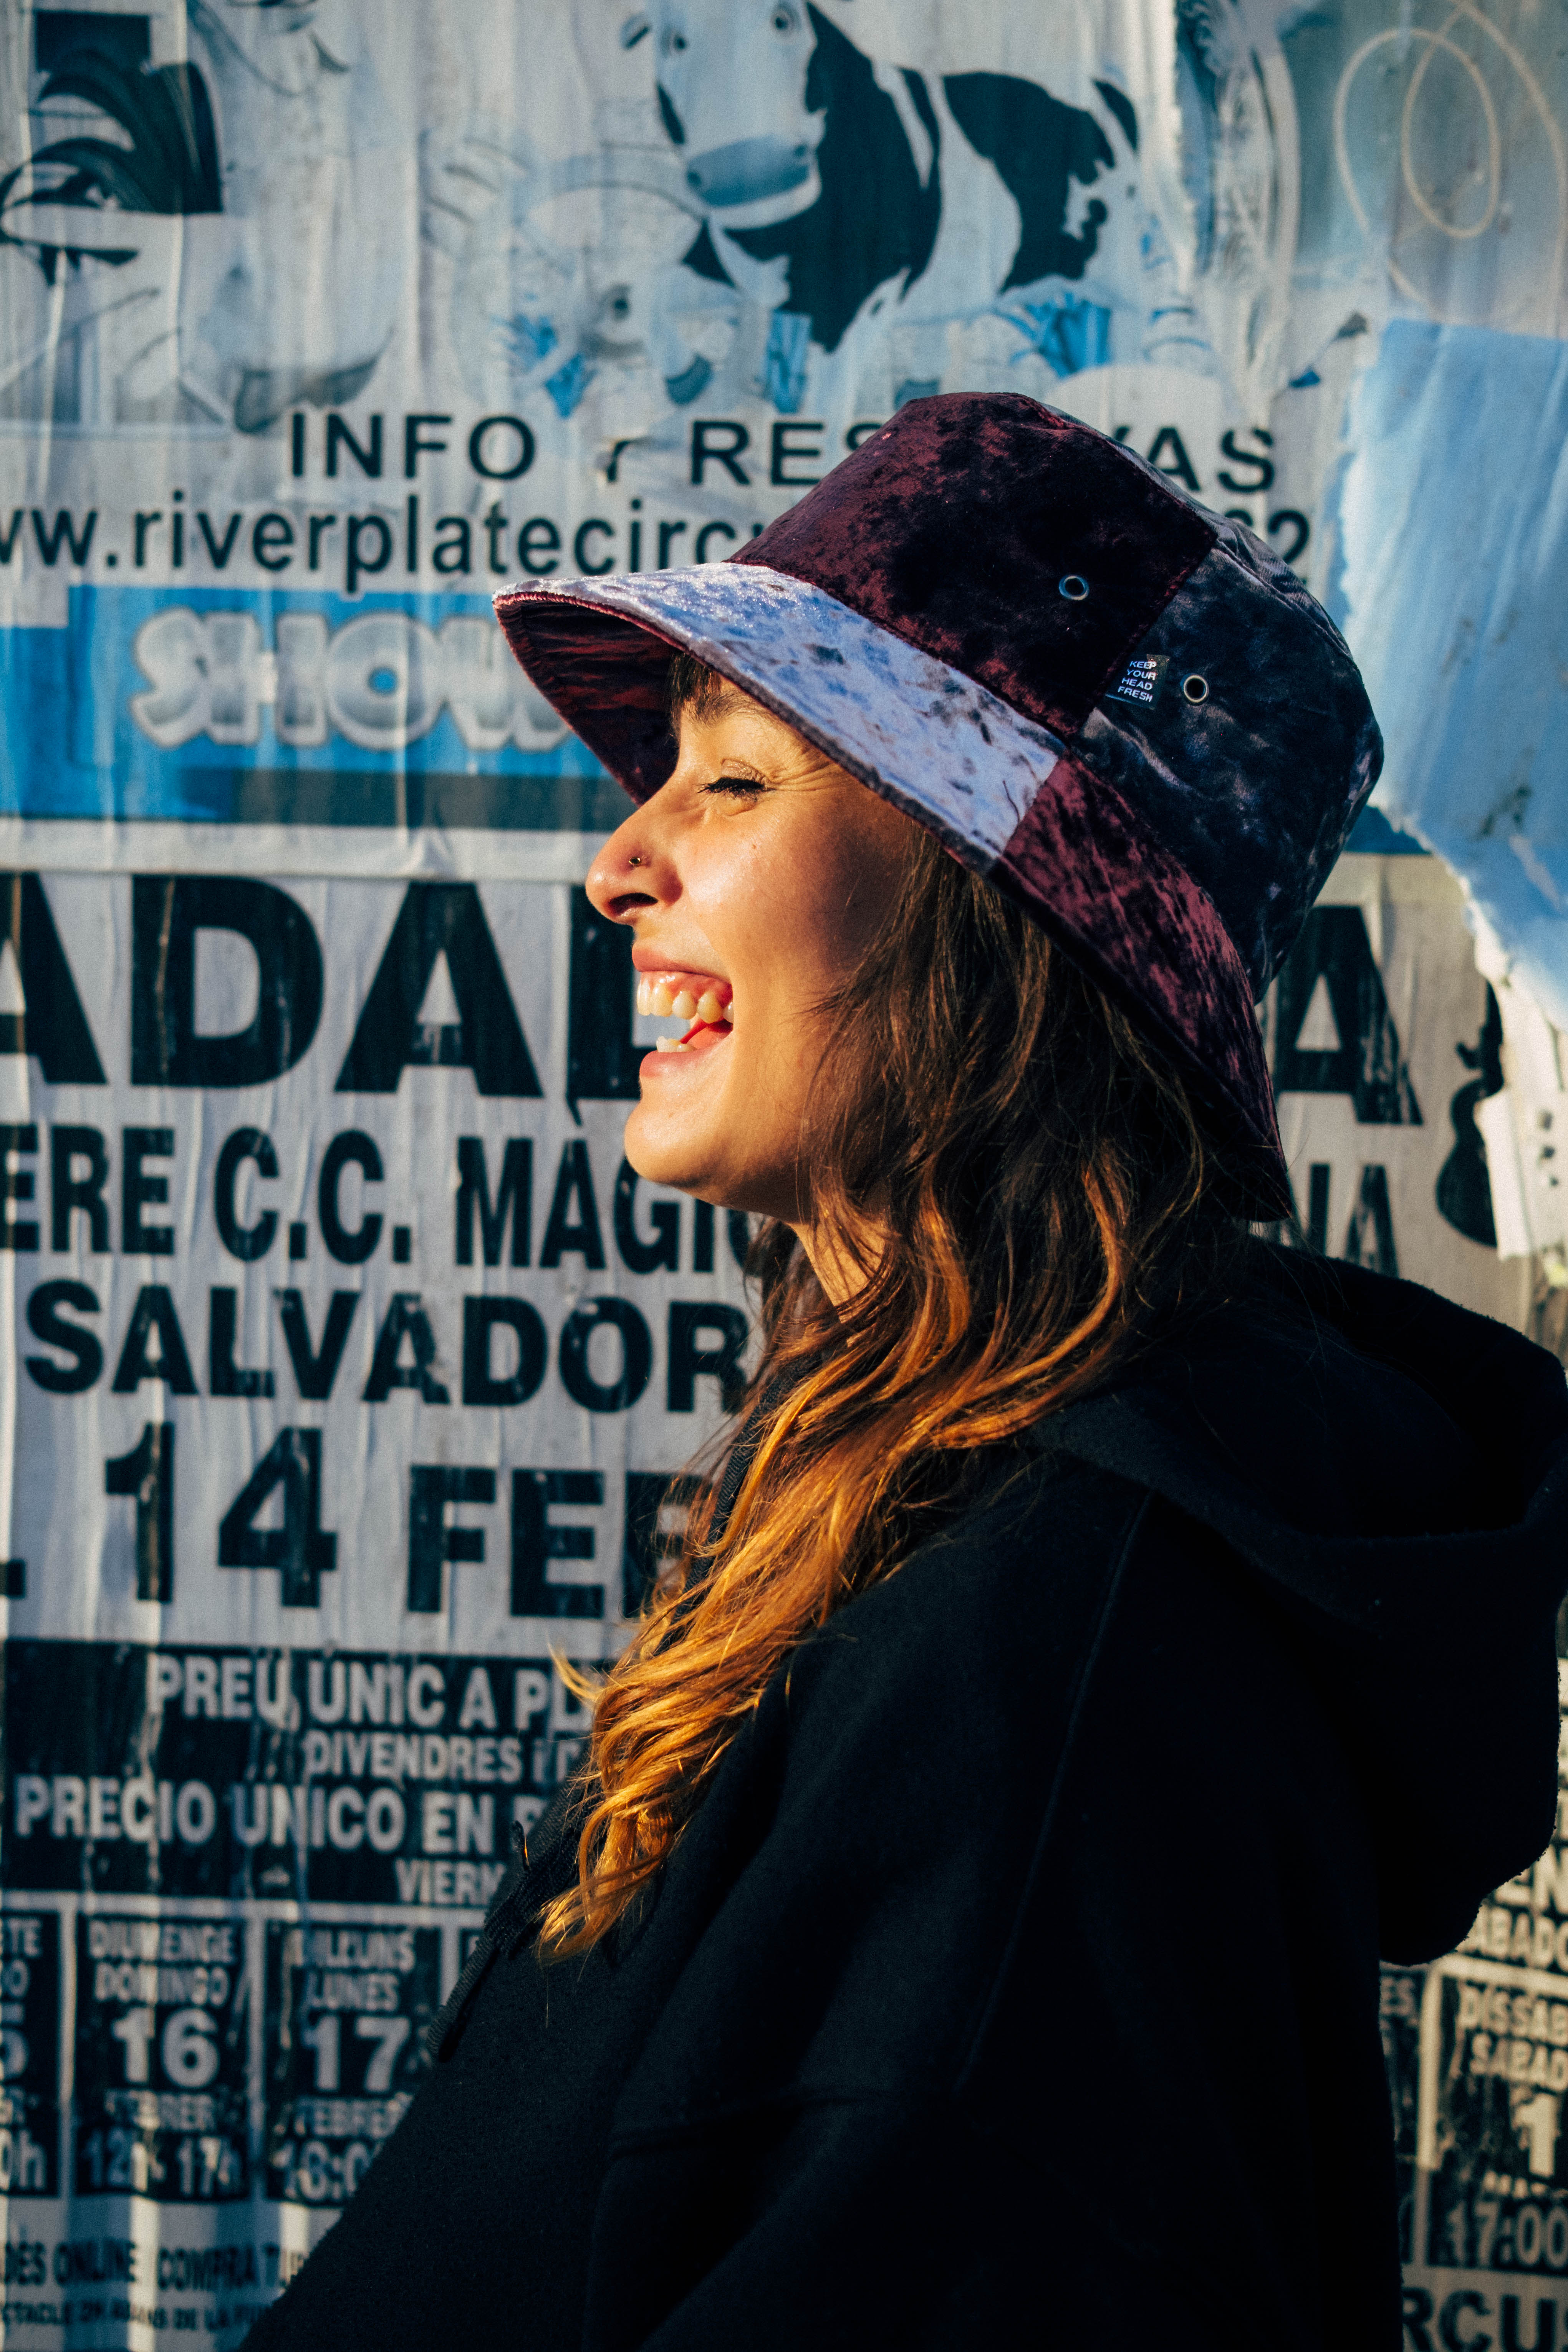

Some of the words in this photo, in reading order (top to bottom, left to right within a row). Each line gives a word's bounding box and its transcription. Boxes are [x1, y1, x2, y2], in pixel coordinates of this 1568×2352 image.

[291, 412, 535, 480] INFO
[0, 491, 765, 593] w.riverplatecirc
[1118, 686, 1152, 702] FRESH
[1122, 677, 1152, 691] HEAD
[1126, 669, 1156, 681] YOUR
[1129, 661, 1157, 669] KEEP
[214, 1125, 413, 1266] C.C.
[24, 1277, 753, 1414] SALVADOR
[104, 1421, 339, 1610] 14
[145, 1653, 292, 1723] PREU
[460, 1666, 498, 1730] A
[514, 1668, 593, 1731] PL
[306, 1729, 523, 1785] DIVENDRES
[14, 1774, 216, 1844] PRECIO
[421, 1791, 494, 1855] EN
[111, 2006, 221, 2089] 16
[305, 2016, 411, 2093] 17
